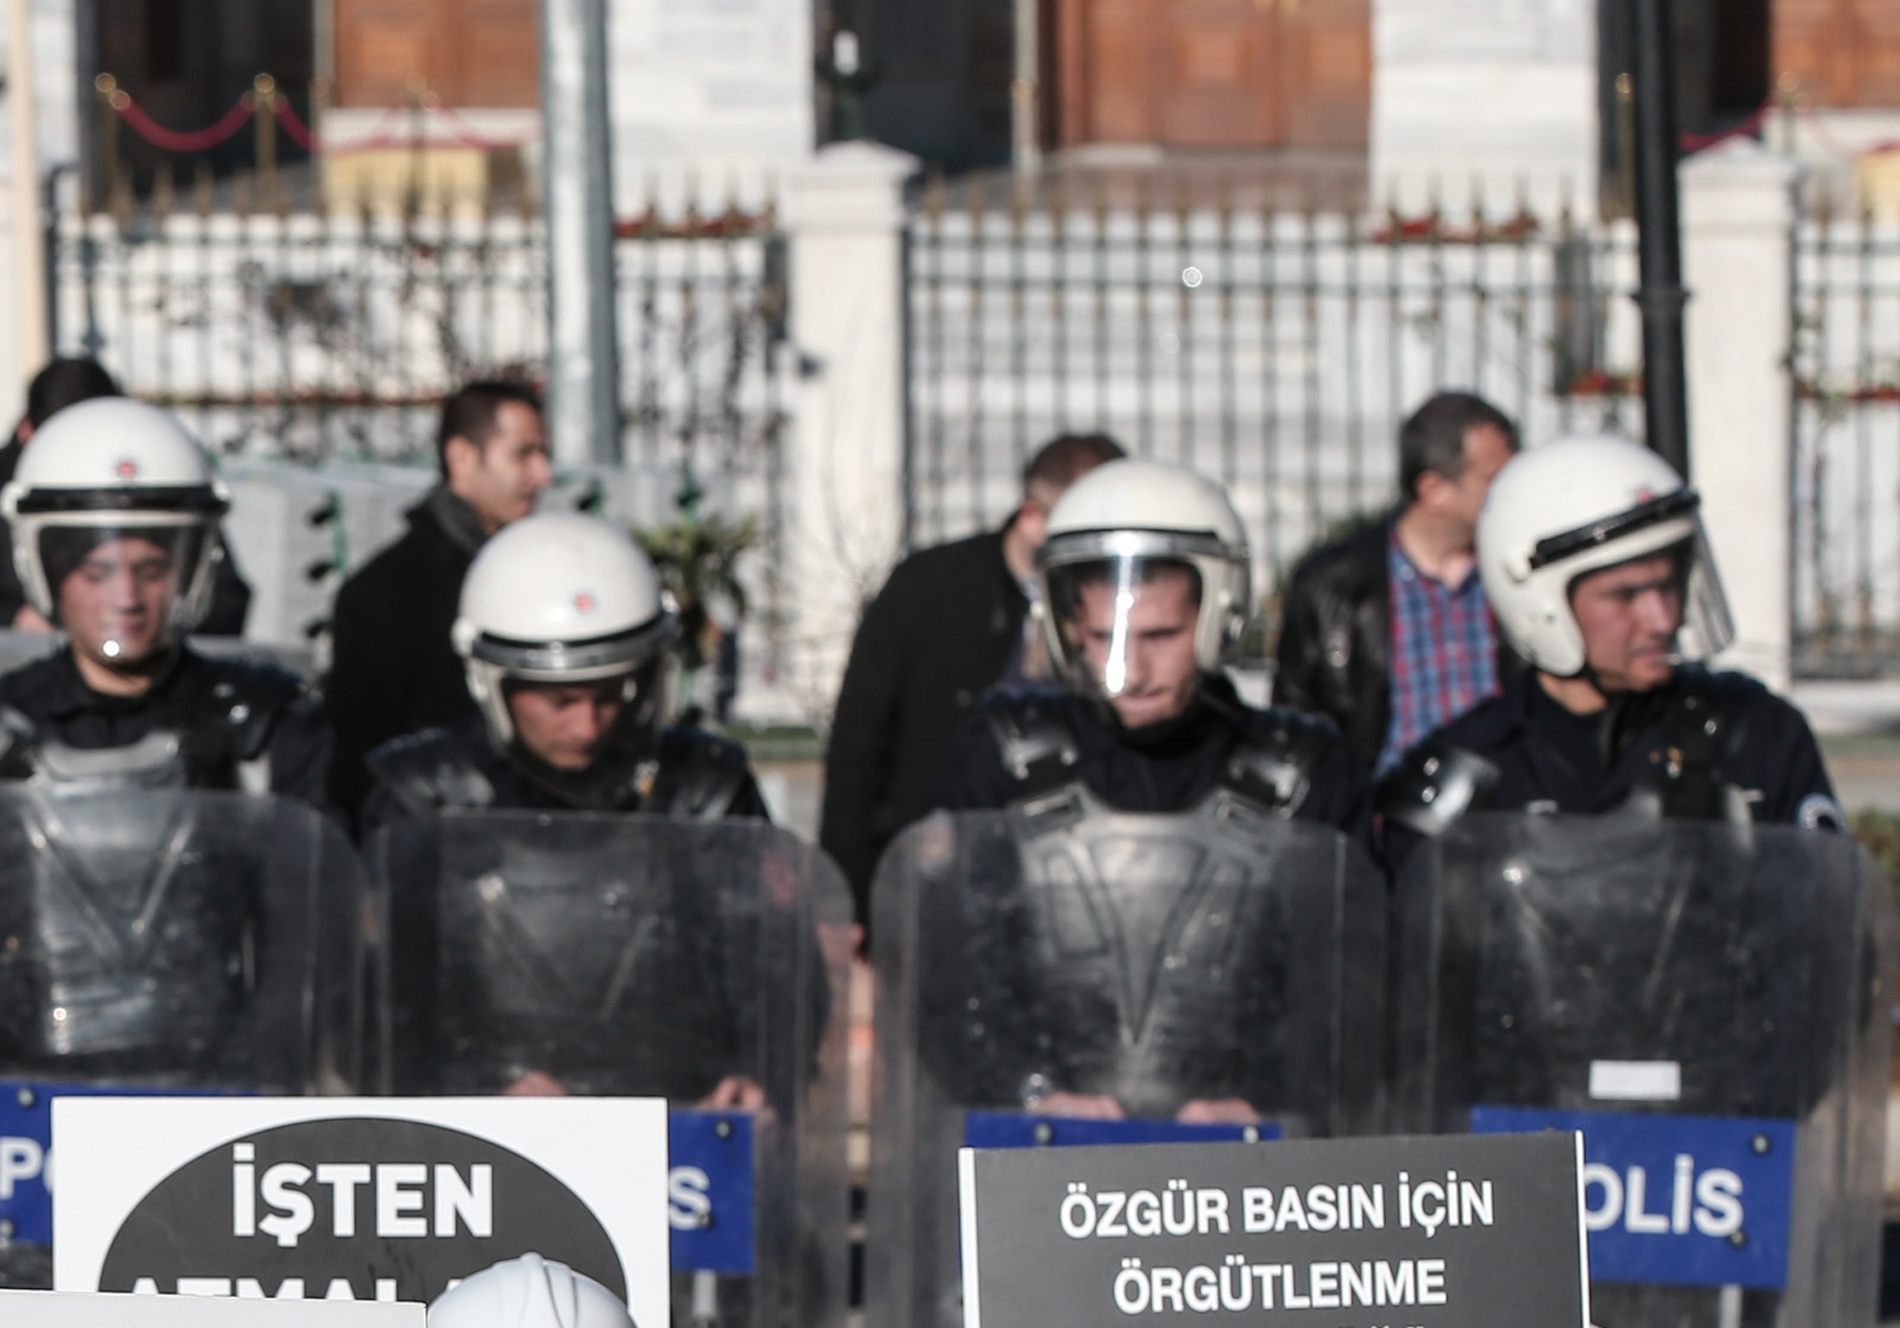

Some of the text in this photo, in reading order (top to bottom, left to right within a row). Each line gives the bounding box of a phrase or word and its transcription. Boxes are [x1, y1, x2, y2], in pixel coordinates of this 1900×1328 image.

[232, 1142, 493, 1248] İŞTEN
[1059, 1170, 1494, 1239] ÖZGÜR BASIN İÇİN
[1112, 1254, 1447, 1315] ÖRGÜTLENME
